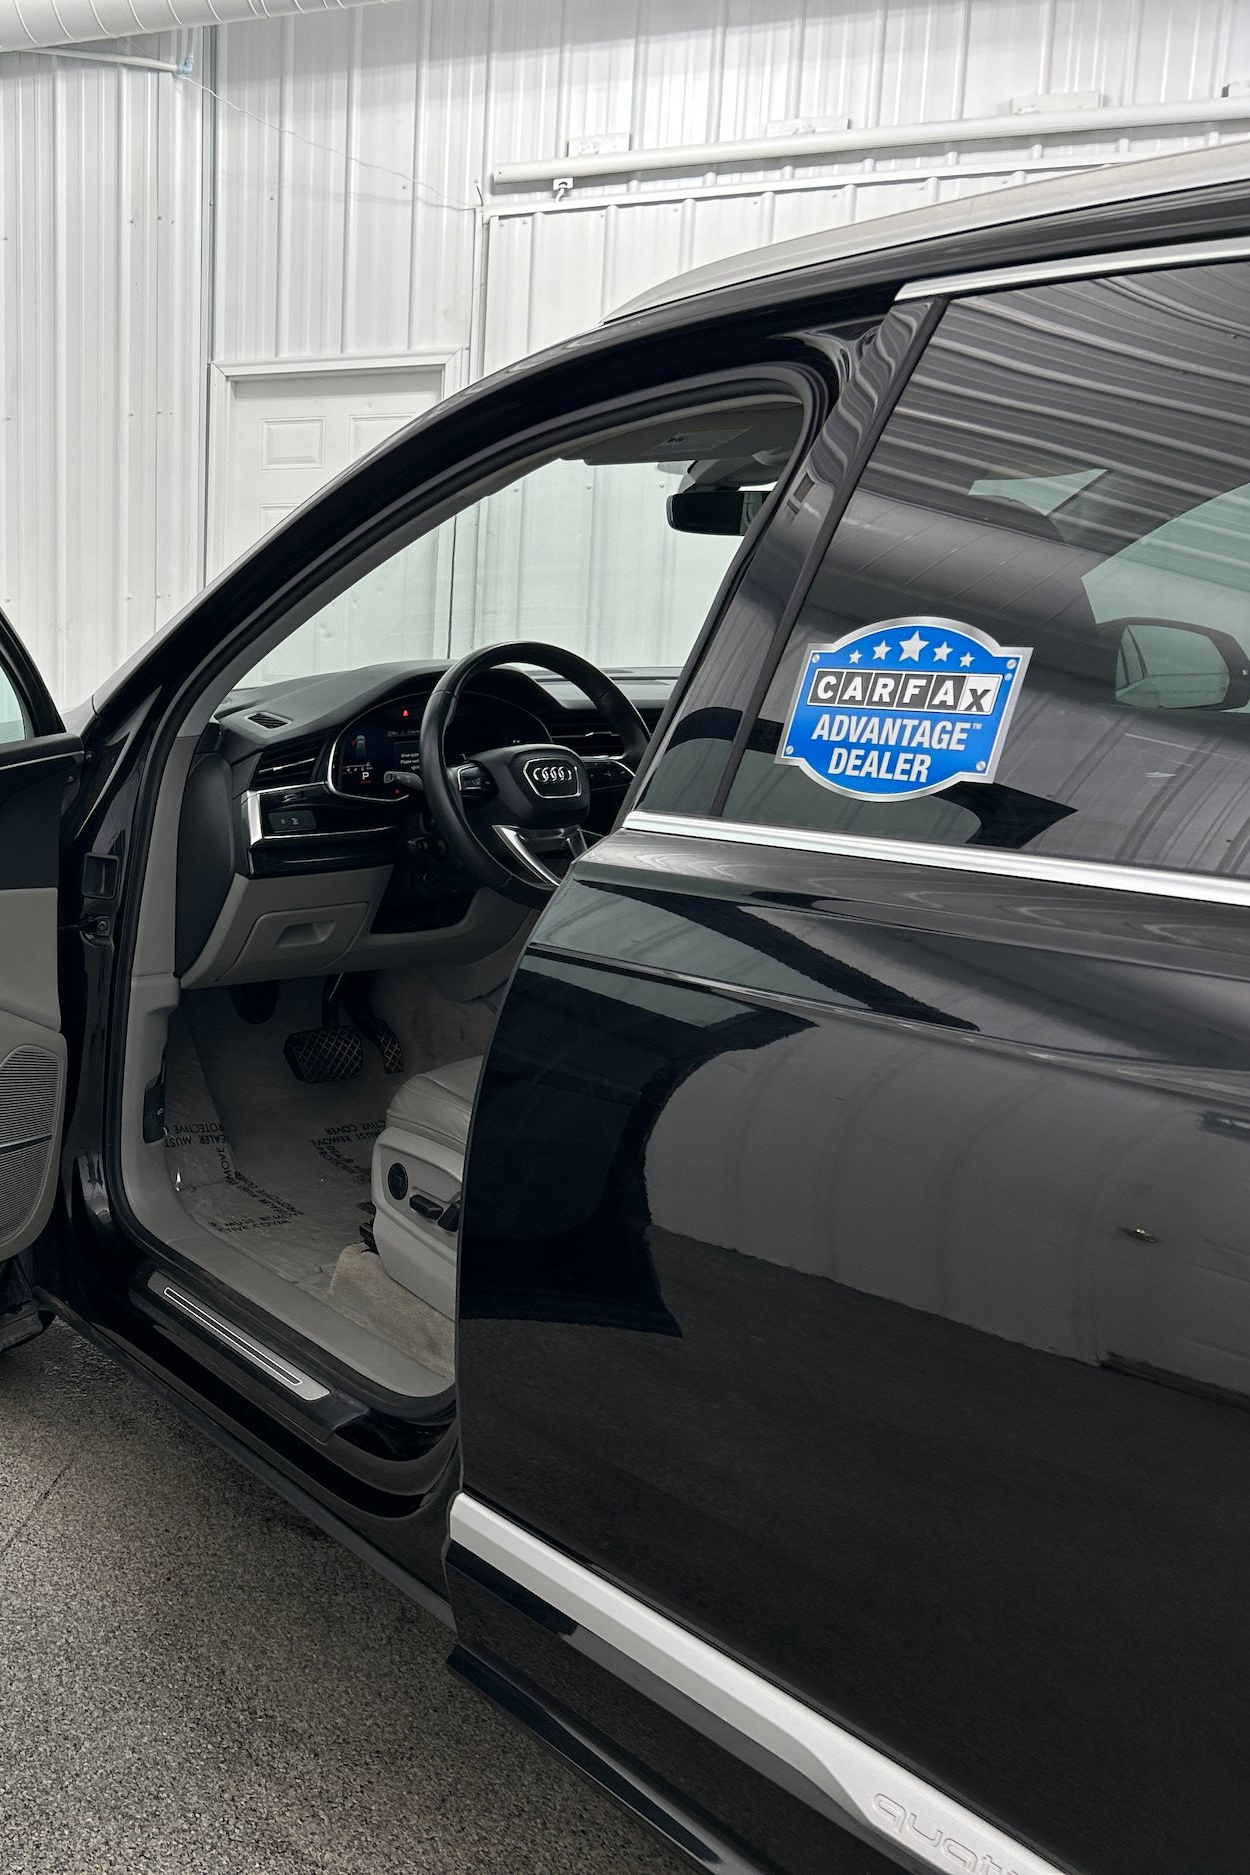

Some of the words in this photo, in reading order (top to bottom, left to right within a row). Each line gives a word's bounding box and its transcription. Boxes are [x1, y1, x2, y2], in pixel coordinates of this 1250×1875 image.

[817, 675, 992, 712] CARFAX
[362, 772, 370, 780] P
[827, 747, 932, 783] DEALER
[164, 1135, 192, 1148] MUST
